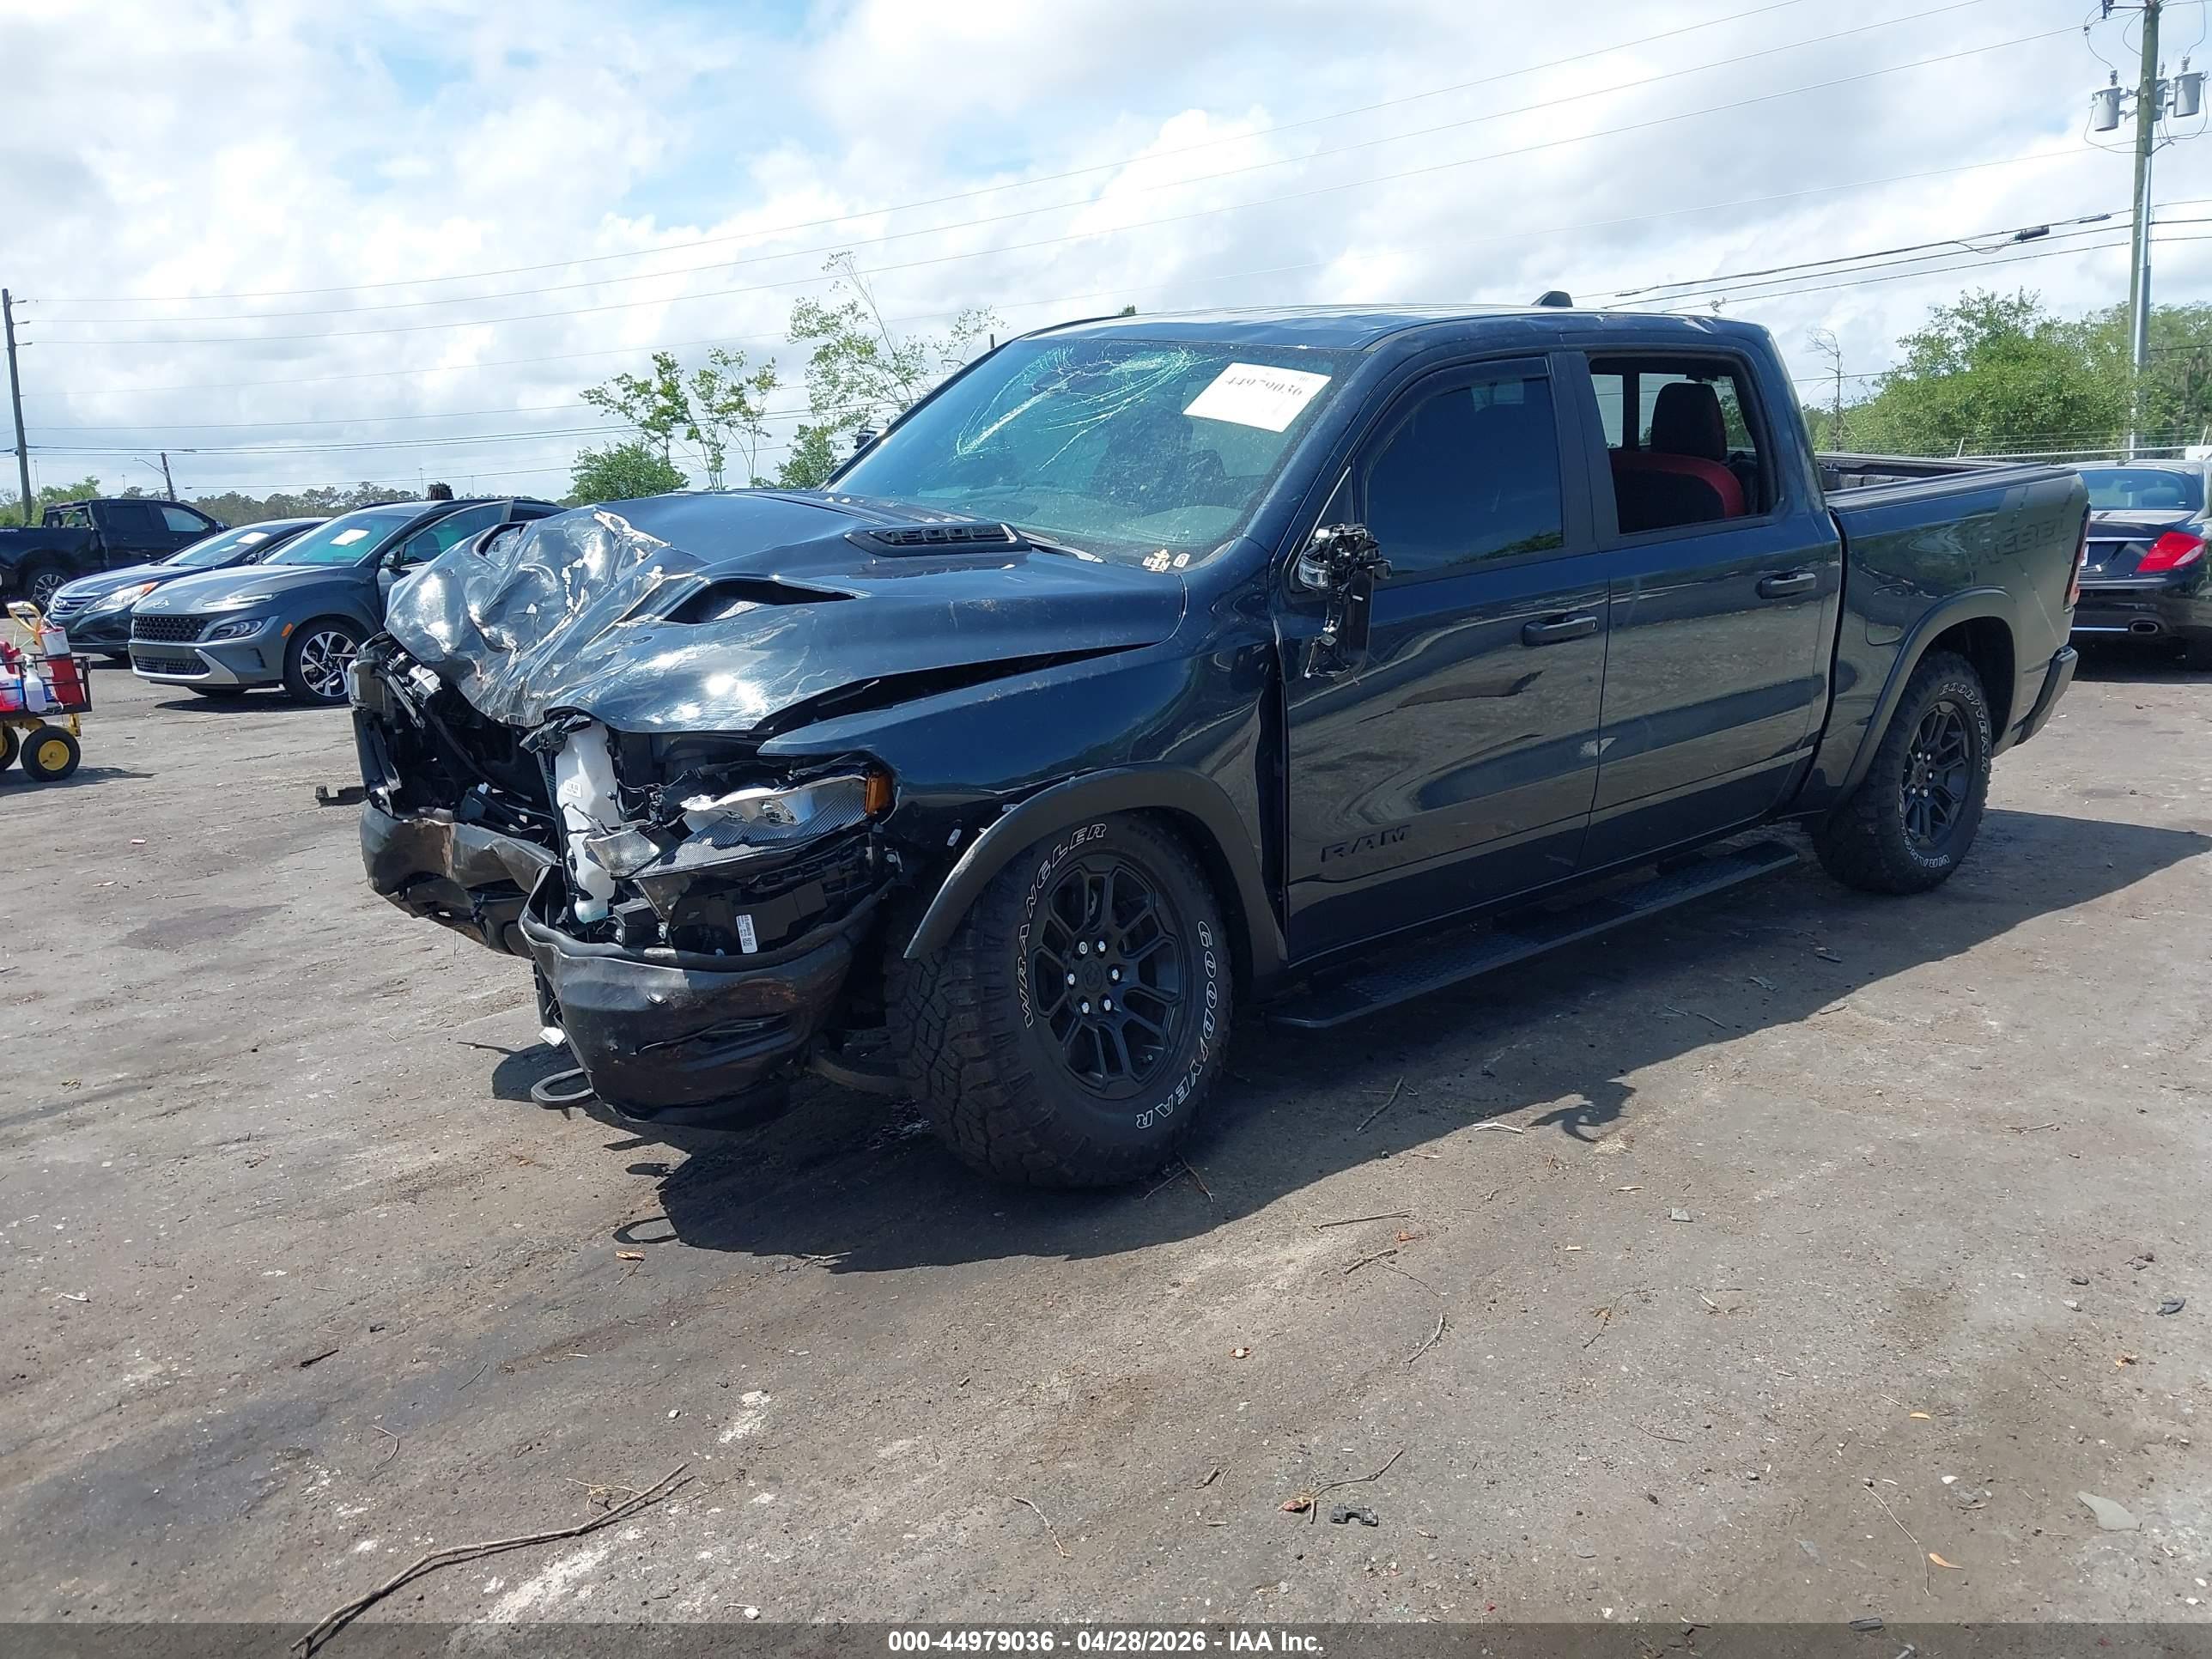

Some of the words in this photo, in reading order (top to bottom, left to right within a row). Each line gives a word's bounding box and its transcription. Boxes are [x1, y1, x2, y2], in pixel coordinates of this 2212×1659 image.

[1015, 822, 1108, 1030] WRANGLER
[1321, 824, 1411, 863] RAM
[1135, 920, 1219, 1131] GOODYEAR
